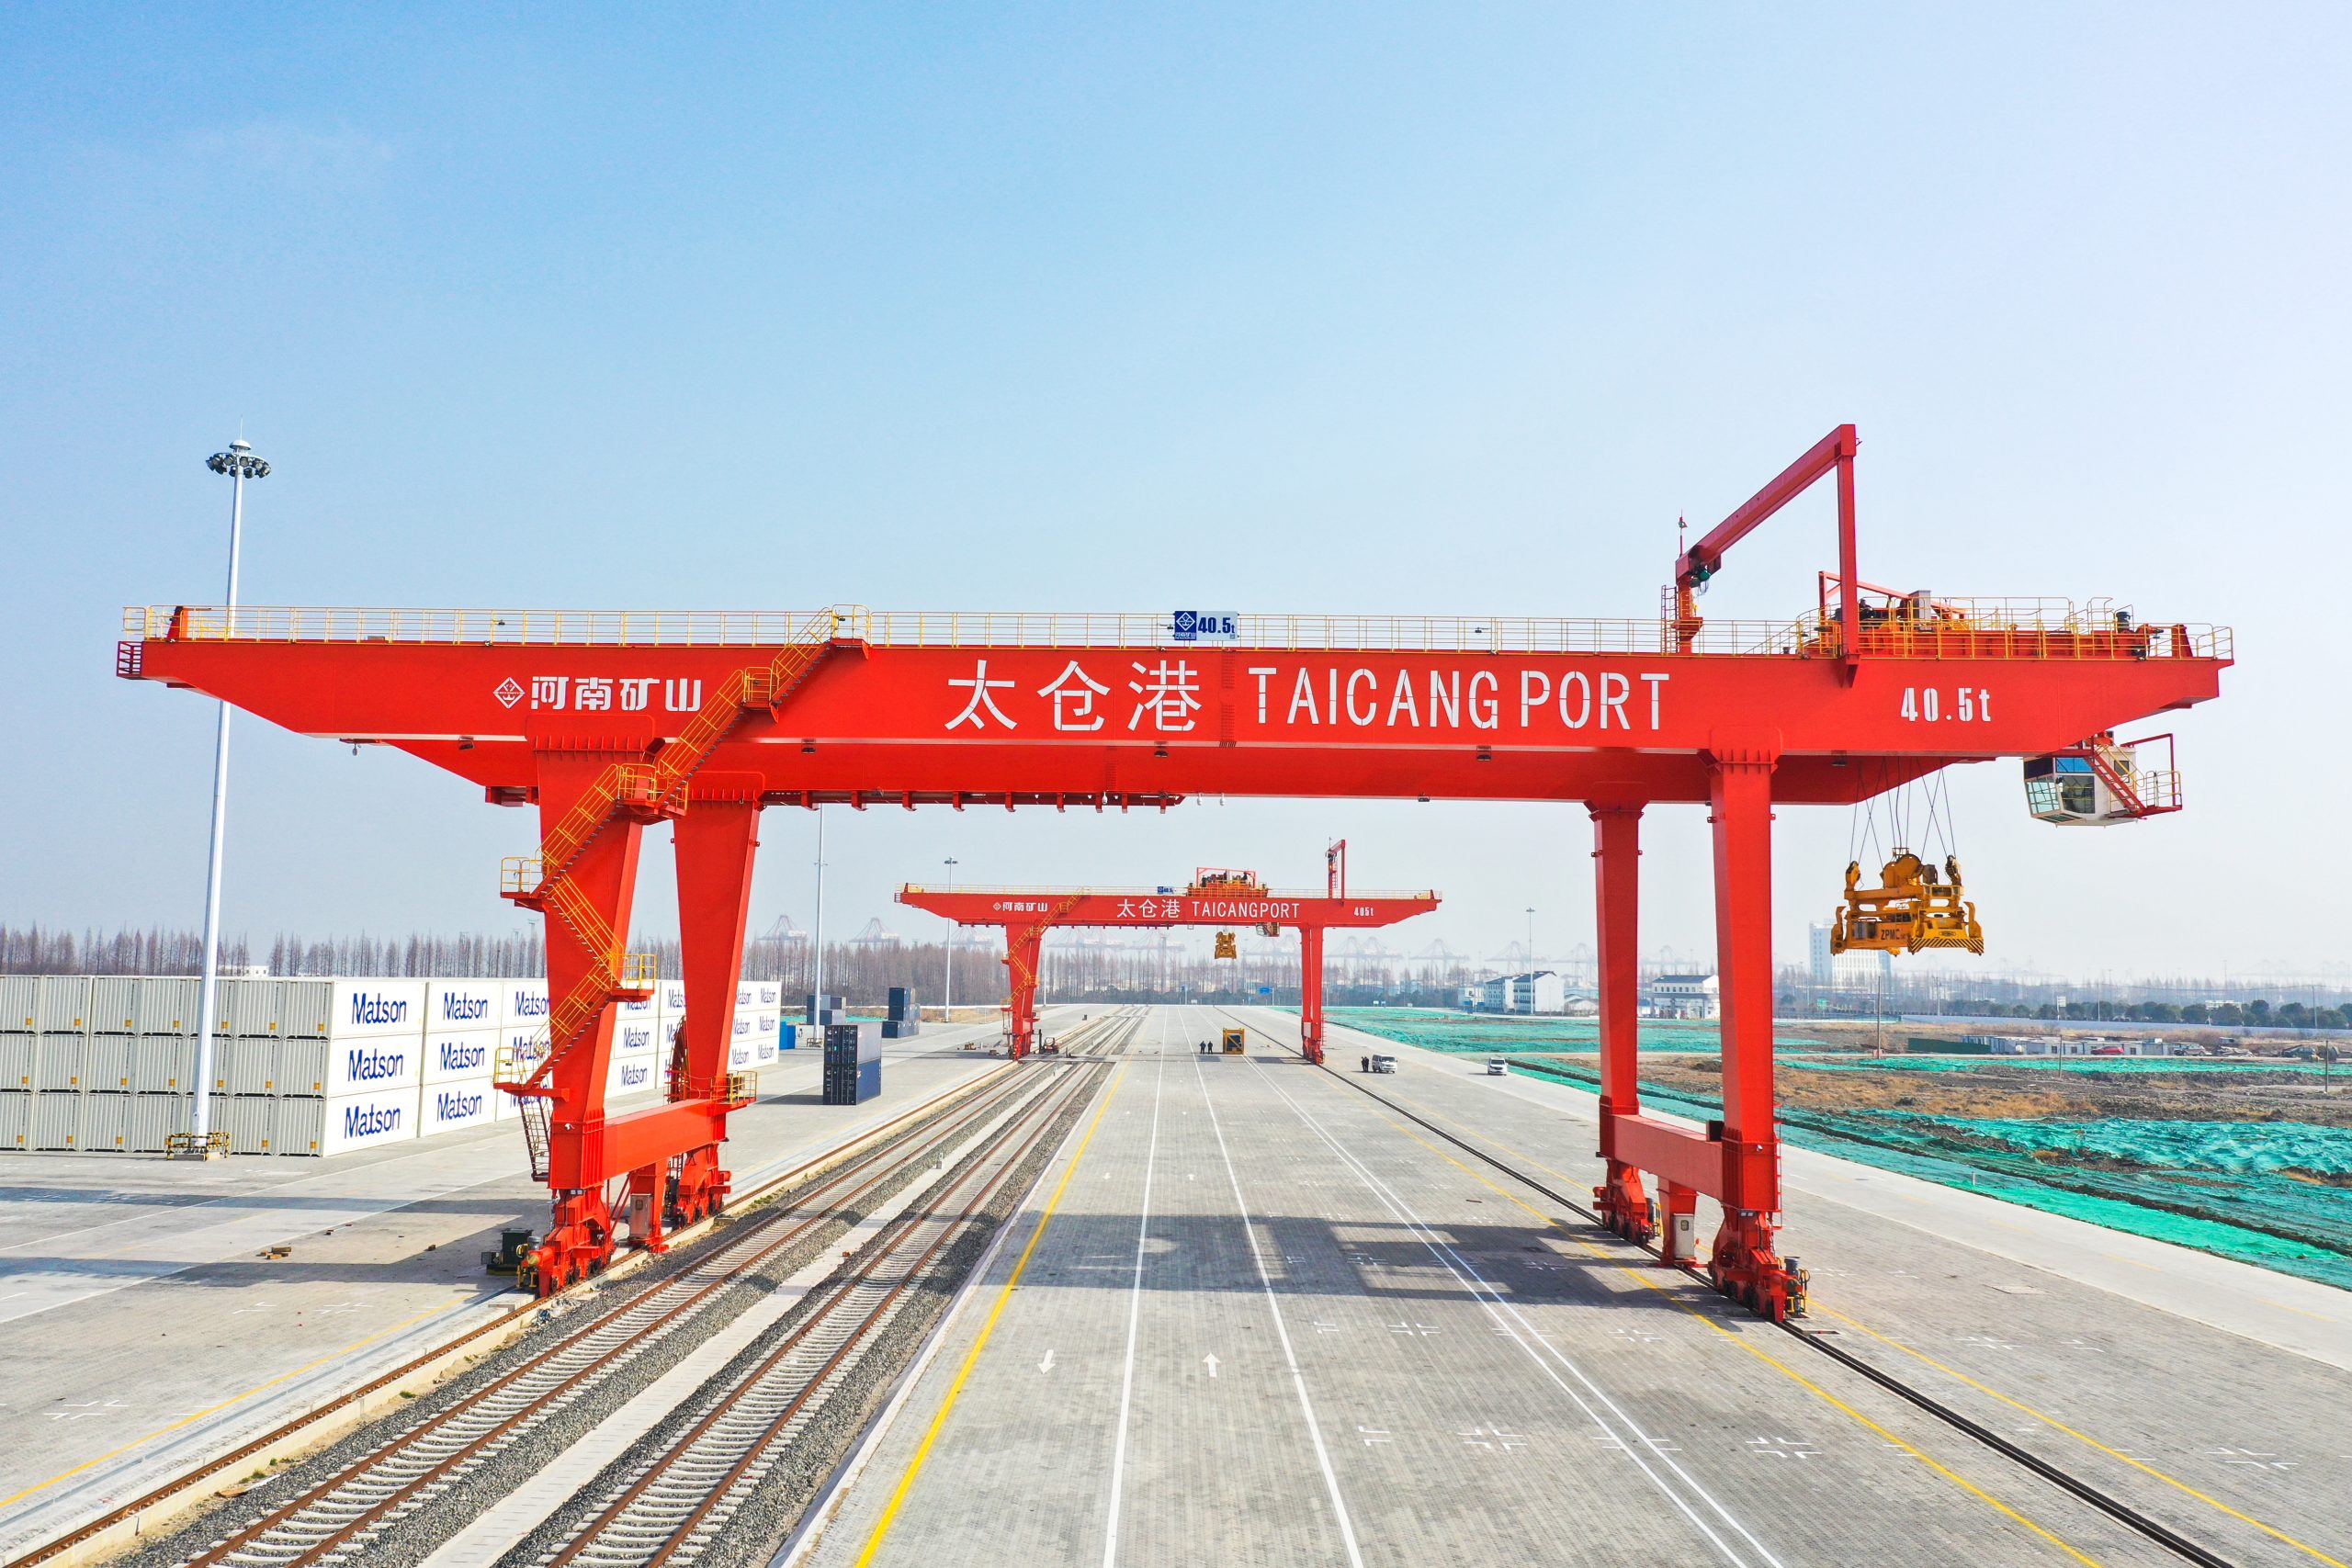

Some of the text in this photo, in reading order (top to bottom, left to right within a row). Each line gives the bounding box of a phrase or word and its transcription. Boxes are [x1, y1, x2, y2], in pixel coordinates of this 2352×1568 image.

[1198, 616, 1235, 634] 40.5t
[530, 676, 702, 712] 河南矿山
[944, 659, 1669, 732] 太仓港 TAICANG PORT
[1900, 687, 1992, 722] 40.5t
[1002, 901, 1048, 912] 河南矿山
[1116, 898, 1181, 918] 太仓港
[352, 993, 407, 1024] Matson
[443, 992, 488, 1021] Matson
[623, 1027, 650, 1049] Matson
[347, 1048, 403, 1082] Matson
[440, 1042, 485, 1071] Matson
[621, 1064, 648, 1087] Matson
[344, 1103, 401, 1139] Matson
[436, 1090, 482, 1122] Matson
